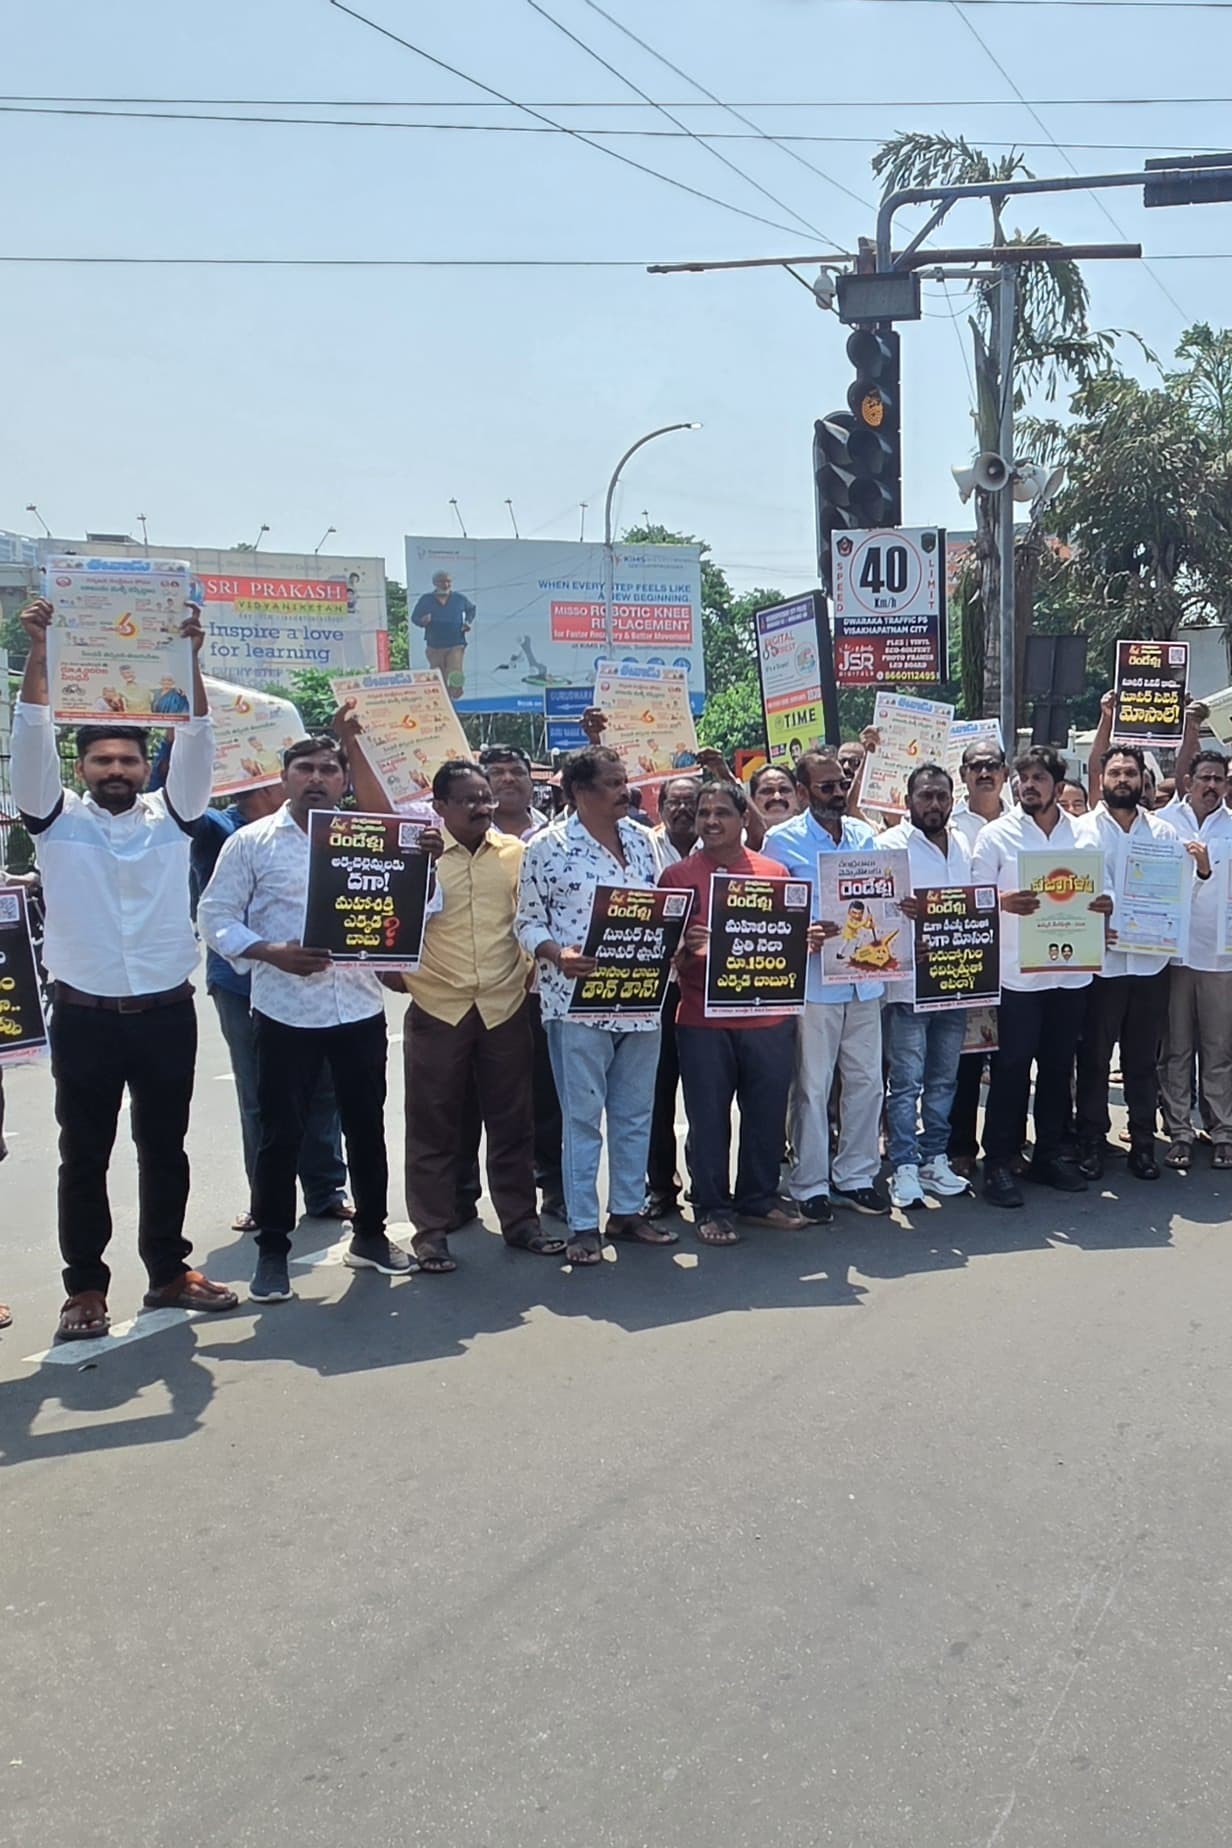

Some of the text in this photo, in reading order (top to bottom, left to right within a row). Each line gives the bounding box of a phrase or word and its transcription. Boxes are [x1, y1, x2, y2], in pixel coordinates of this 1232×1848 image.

[859, 546, 907, 593] 40
[207, 579, 341, 600] SRI PRAKASH
[538, 580, 691, 593] WHEN EVERY TEP FEELS LIKE
[611, 593, 631, 601] EW
[634, 594, 689, 602] BEGINNING
[554, 607, 587, 616] MISSO
[654, 608, 690, 618] KNEE
[844, 616, 928, 626] DWARAKA TRAFFIC PS
[118, 612, 136, 636] 6
[210, 622, 344, 641] Inspire a love
[843, 625, 928, 635] VISAKHAPATNAM CITY
[211, 642, 330, 664] for learning
[838, 651, 874, 670] JSR
[784, 708, 816, 729] TIME
